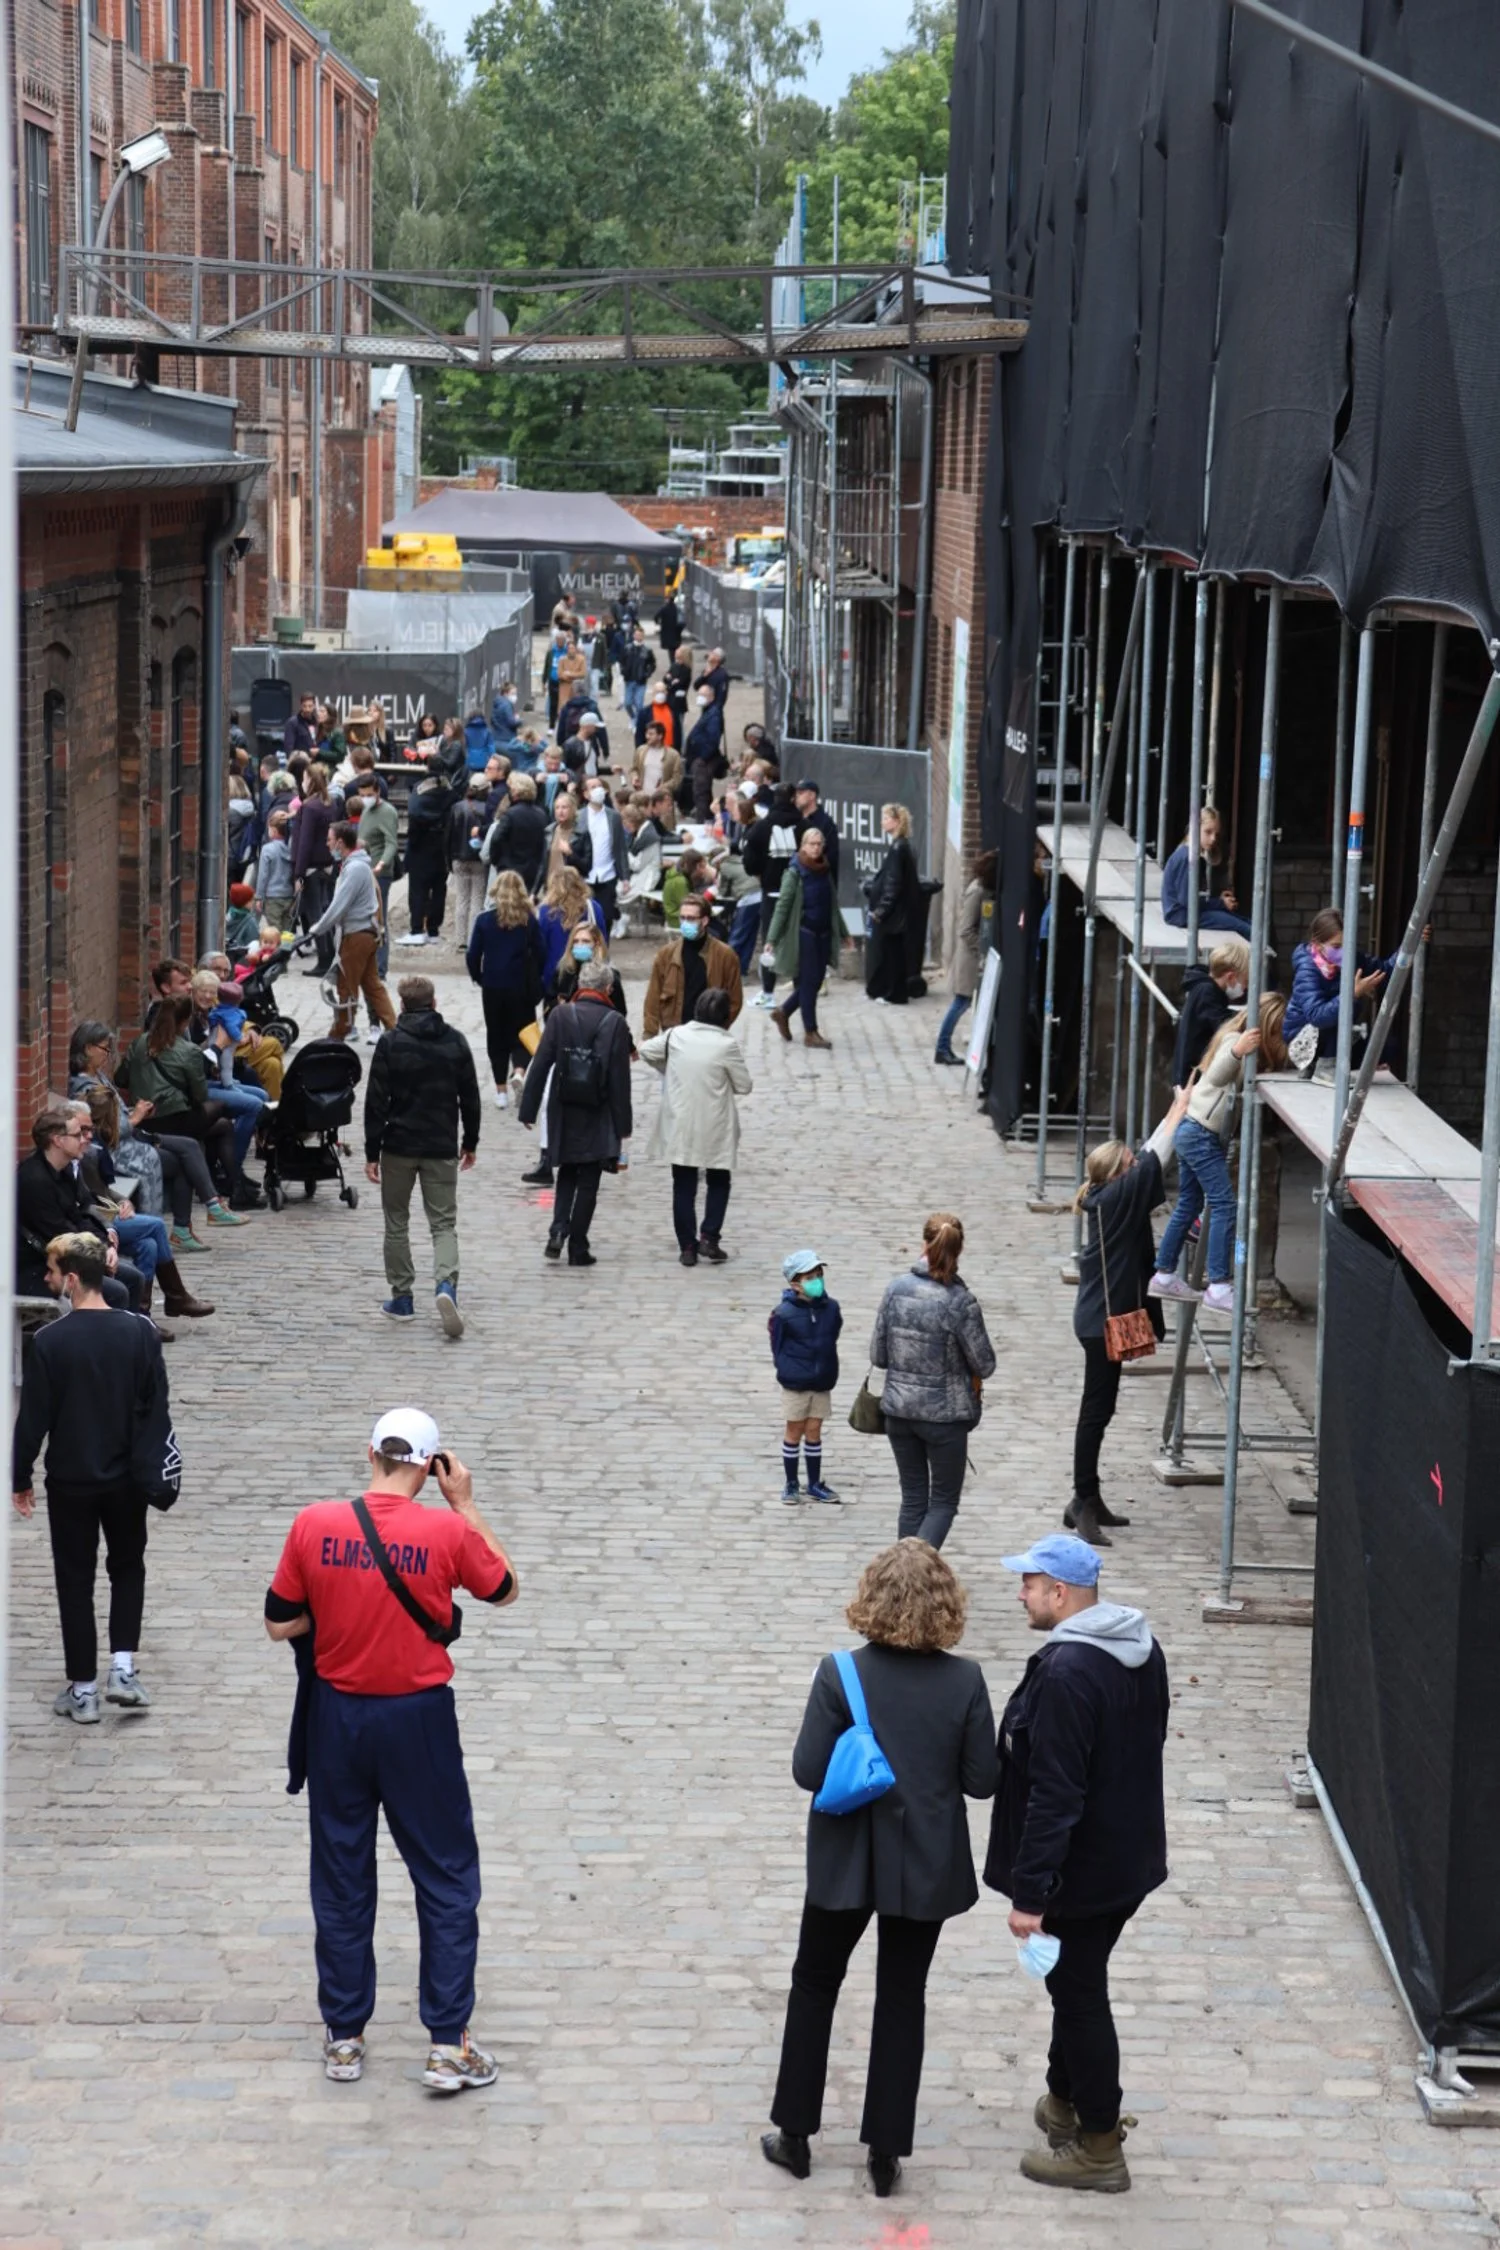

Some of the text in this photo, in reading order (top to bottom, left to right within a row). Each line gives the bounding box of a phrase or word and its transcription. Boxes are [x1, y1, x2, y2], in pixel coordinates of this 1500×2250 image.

[558, 573, 640, 589] WILHELM
[817, 798, 895, 845] ILHEL
[321, 1537, 428, 1576] ELMSORN
